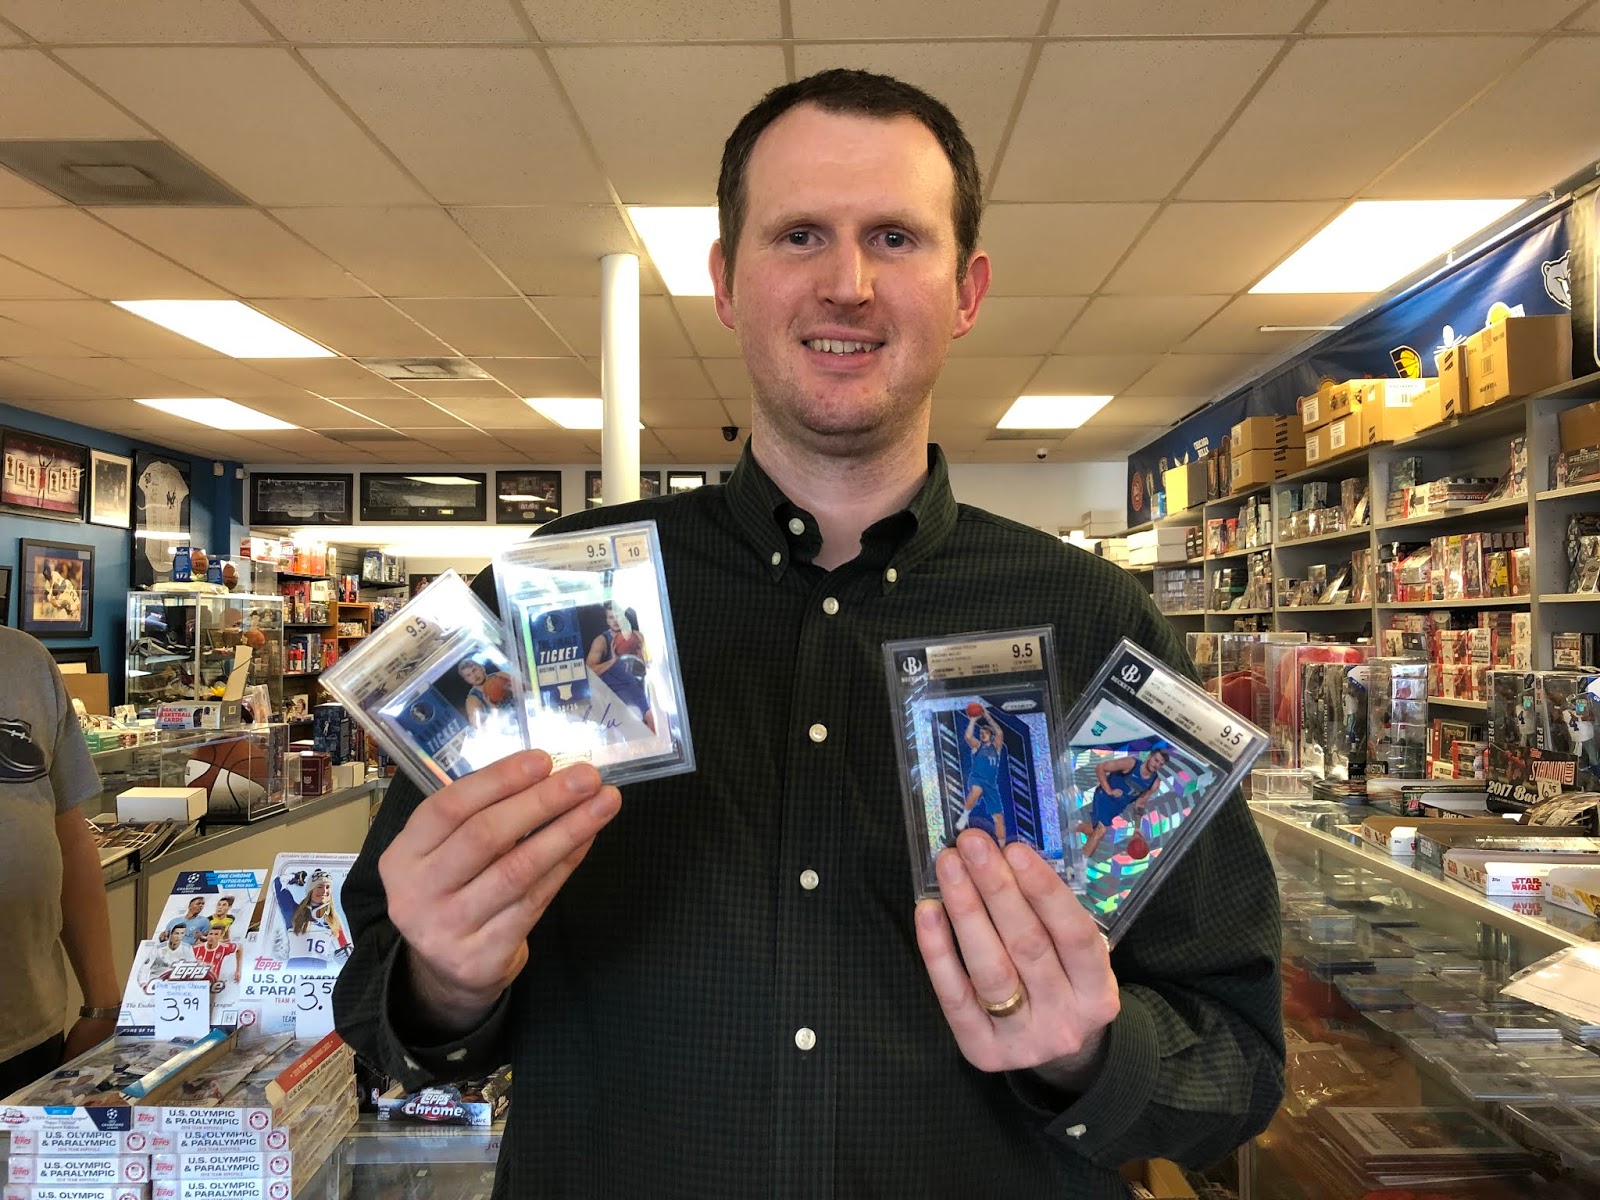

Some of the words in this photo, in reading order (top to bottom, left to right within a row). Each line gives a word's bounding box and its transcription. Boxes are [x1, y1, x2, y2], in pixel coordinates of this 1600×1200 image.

[586, 543, 606, 558] 9.5
[628, 547, 640, 557] 10
[406, 616, 426, 637] 9.5
[540, 646, 578, 664] TICKET
[1012, 643, 1033, 658] 9.5
[1110, 675, 1136, 696] BECKETT
[1220, 726, 1243, 746] 9.5
[1529, 761, 1566, 782] STADIUM
[1565, 761, 1575, 785] CLUB
[1486, 780, 1513, 798] 2017
[306, 938, 326, 954] 16
[169, 960, 212, 979] Topps
[254, 956, 283, 970] Topps
[252, 974, 278, 984] U.S.
[245, 986, 255, 995] &
[420, 1088, 452, 1104] Topps
[404, 1102, 463, 1116] Chrome
[191, 1138, 256, 1146] PARALYMPIC
[210, 1156, 256, 1164] OLYMPIC
[194, 1164, 260, 1172] PARALYMPIC
[188, 1182, 207, 1190] U.S.
[194, 1190, 260, 1198] PARALYMPIC
